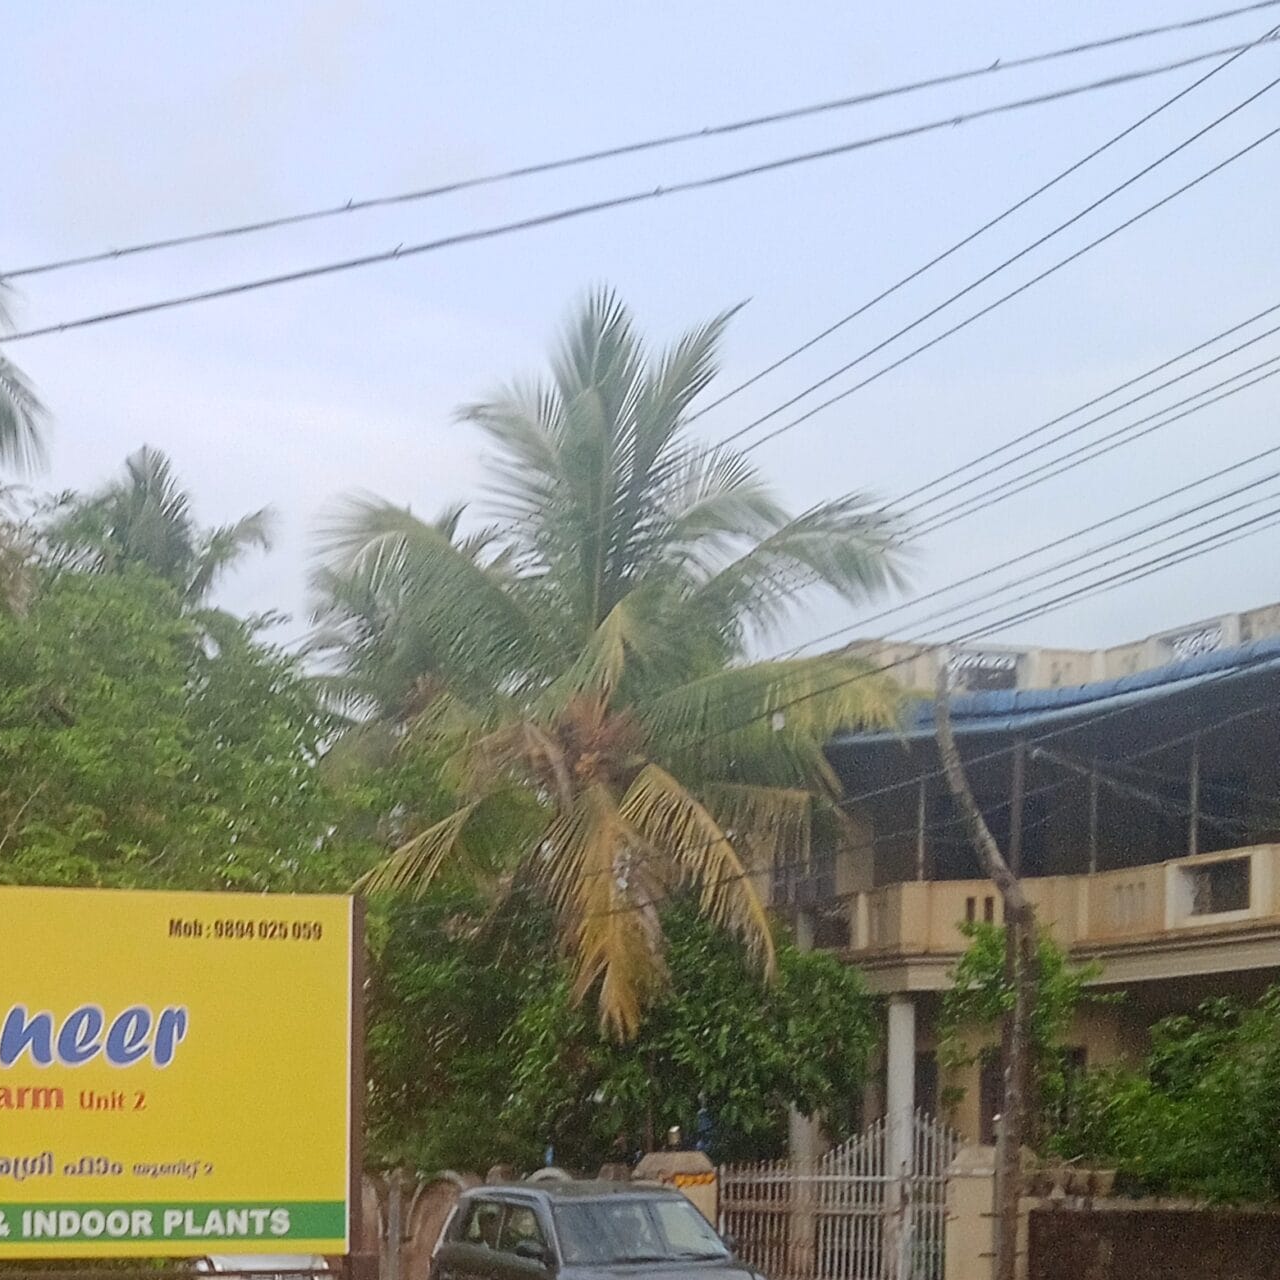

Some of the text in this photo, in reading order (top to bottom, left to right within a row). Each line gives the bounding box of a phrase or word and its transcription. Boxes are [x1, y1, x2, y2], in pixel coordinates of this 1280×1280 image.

[258, 920, 289, 940] 025
[79, 1090, 124, 1111] Unit
[132, 1091, 147, 1112] 2
[63, 1157, 123, 1176] ഫാം
[22, 1209, 153, 1238] INDOOR
[163, 1208, 291, 1237] PLANTS
